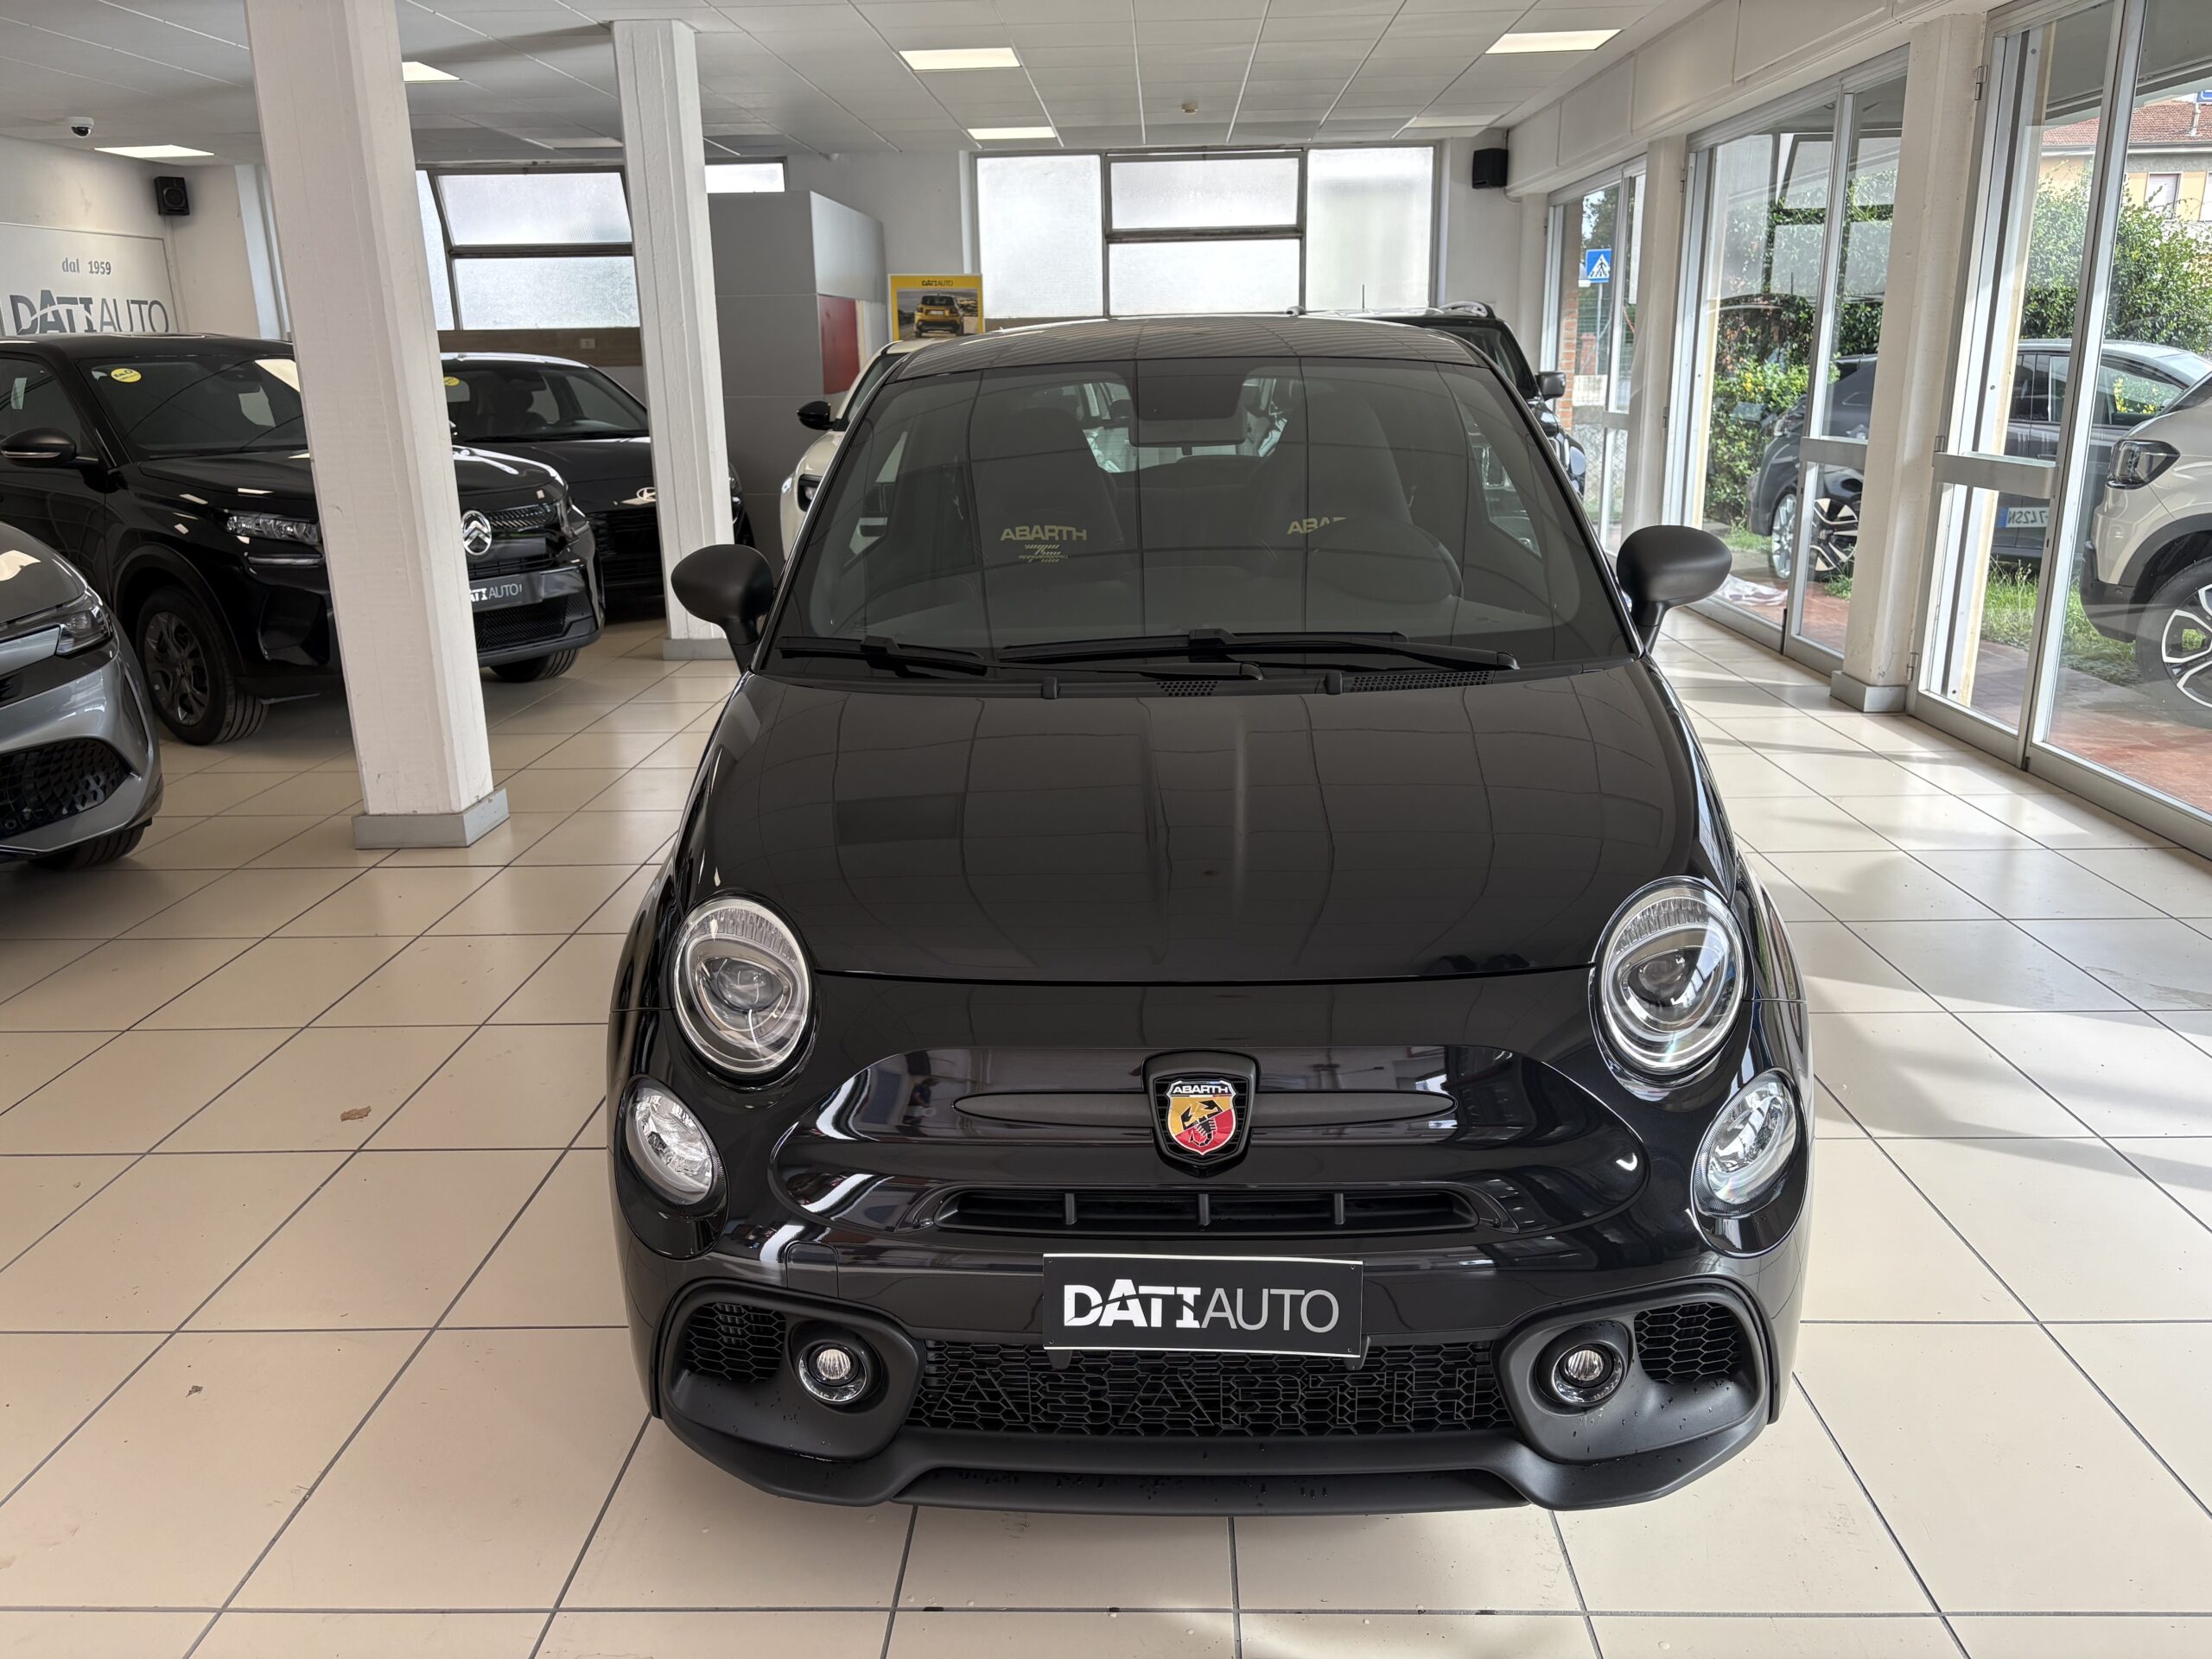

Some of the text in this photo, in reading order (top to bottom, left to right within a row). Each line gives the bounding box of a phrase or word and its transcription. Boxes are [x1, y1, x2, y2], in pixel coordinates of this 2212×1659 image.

[61, 257, 111, 276] dal 1959
[1000, 524, 1088, 541] ABARTH
[1287, 517, 1347, 534] ABA
[1173, 1084, 1229, 1094] ABARTH
[931, 1367, 1477, 1427] ABARTH
